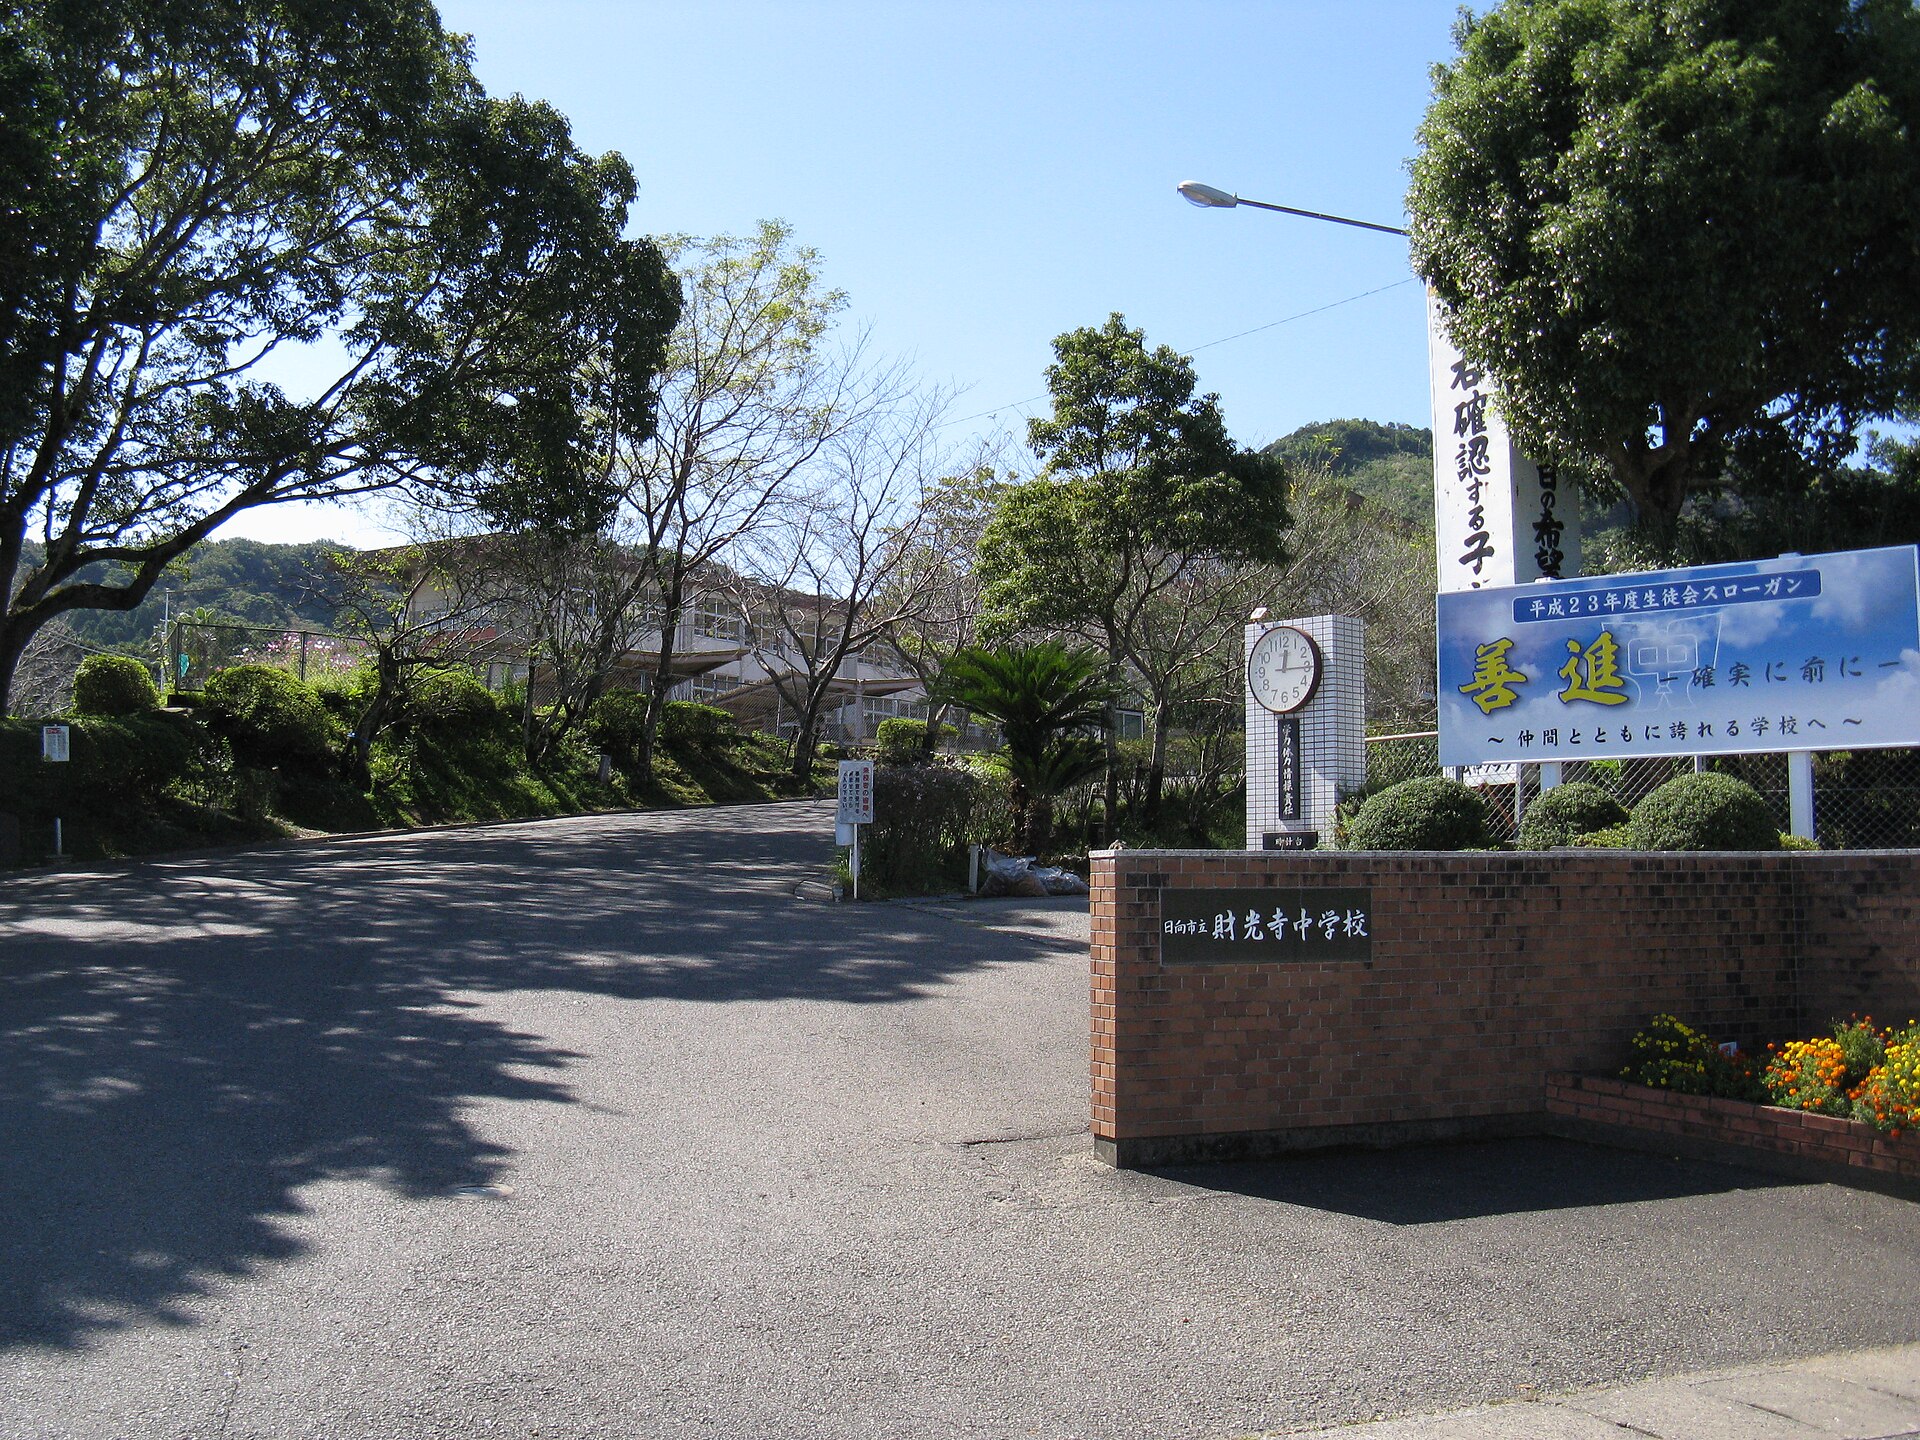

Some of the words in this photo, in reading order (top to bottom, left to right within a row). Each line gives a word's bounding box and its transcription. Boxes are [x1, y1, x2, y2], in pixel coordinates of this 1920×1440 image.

[1450, 350, 1495, 588] 右確認する子
[1529, 576, 1802, 619] 平成23年度生徒会スローガン
[1268, 638, 1278, 652] 11
[1279, 636, 1289, 648] 12
[1259, 651, 1271, 665] 10
[1300, 646, 1307, 659] 2
[1258, 667, 1266, 679] 9
[1303, 660, 1311, 673] 3
[1458, 630, 1630, 716] 善進
[1262, 679, 1270, 691] 8
[1300, 675, 1308, 687] 4
[1271, 689, 1279, 701] 7
[1281, 691, 1288, 704] 6
[1292, 687, 1300, 699] 5
